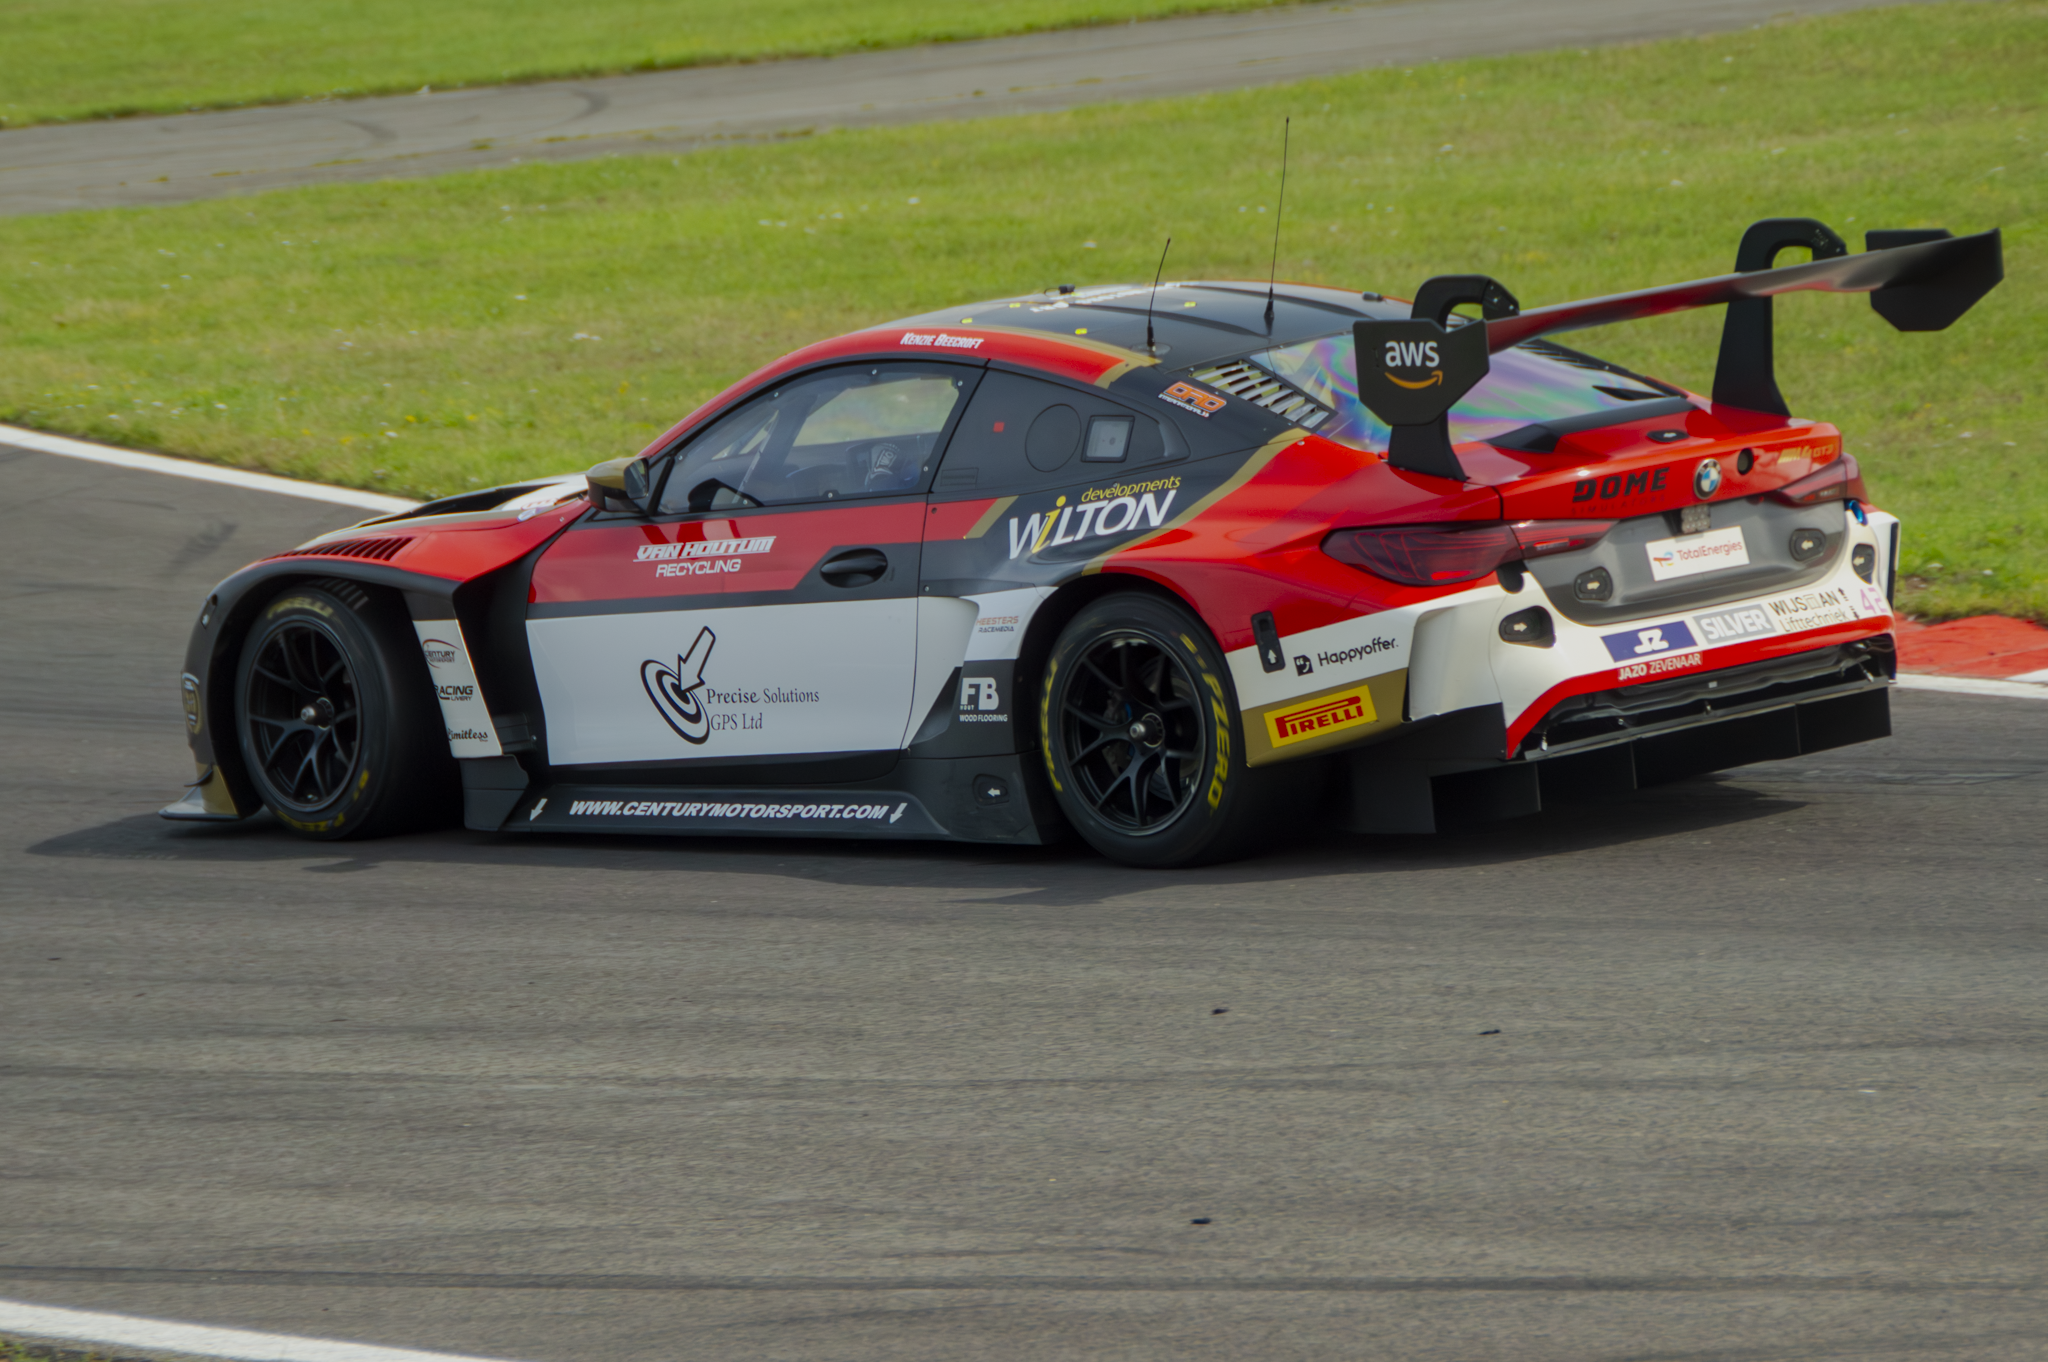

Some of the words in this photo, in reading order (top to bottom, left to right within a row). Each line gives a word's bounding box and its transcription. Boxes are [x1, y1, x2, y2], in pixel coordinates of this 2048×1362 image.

[900, 332, 936, 345] KENZIE
[934, 333, 984, 350] BEECROFT
[1385, 340, 1440, 367] aws
[1081, 476, 1182, 502] developments
[1573, 467, 1670, 503] DOME
[633, 542, 684, 562] VAN
[680, 536, 776, 559] HOUTUM
[1676, 540, 1743, 561] TotalEnergies
[656, 559, 741, 577] RECYCLING
[1860, 587, 1888, 615] 42
[1700, 608, 1772, 640] SILVER
[1618, 663, 1647, 681] JAZO
[1649, 653, 1702, 674] ZEVENAAR
[706, 688, 760, 704] Precise
[763, 687, 819, 703] Solutions
[960, 677, 999, 711] FB
[710, 714, 737, 731] GPS
[742, 712, 762, 730] Ltd
[959, 714, 977, 722] WOOD
[978, 714, 1008, 722] FLOORING
[1275, 696, 1364, 739] PIRELLI
[569, 800, 888, 820] WWW.CENTURYMOTORSPORT.COM
